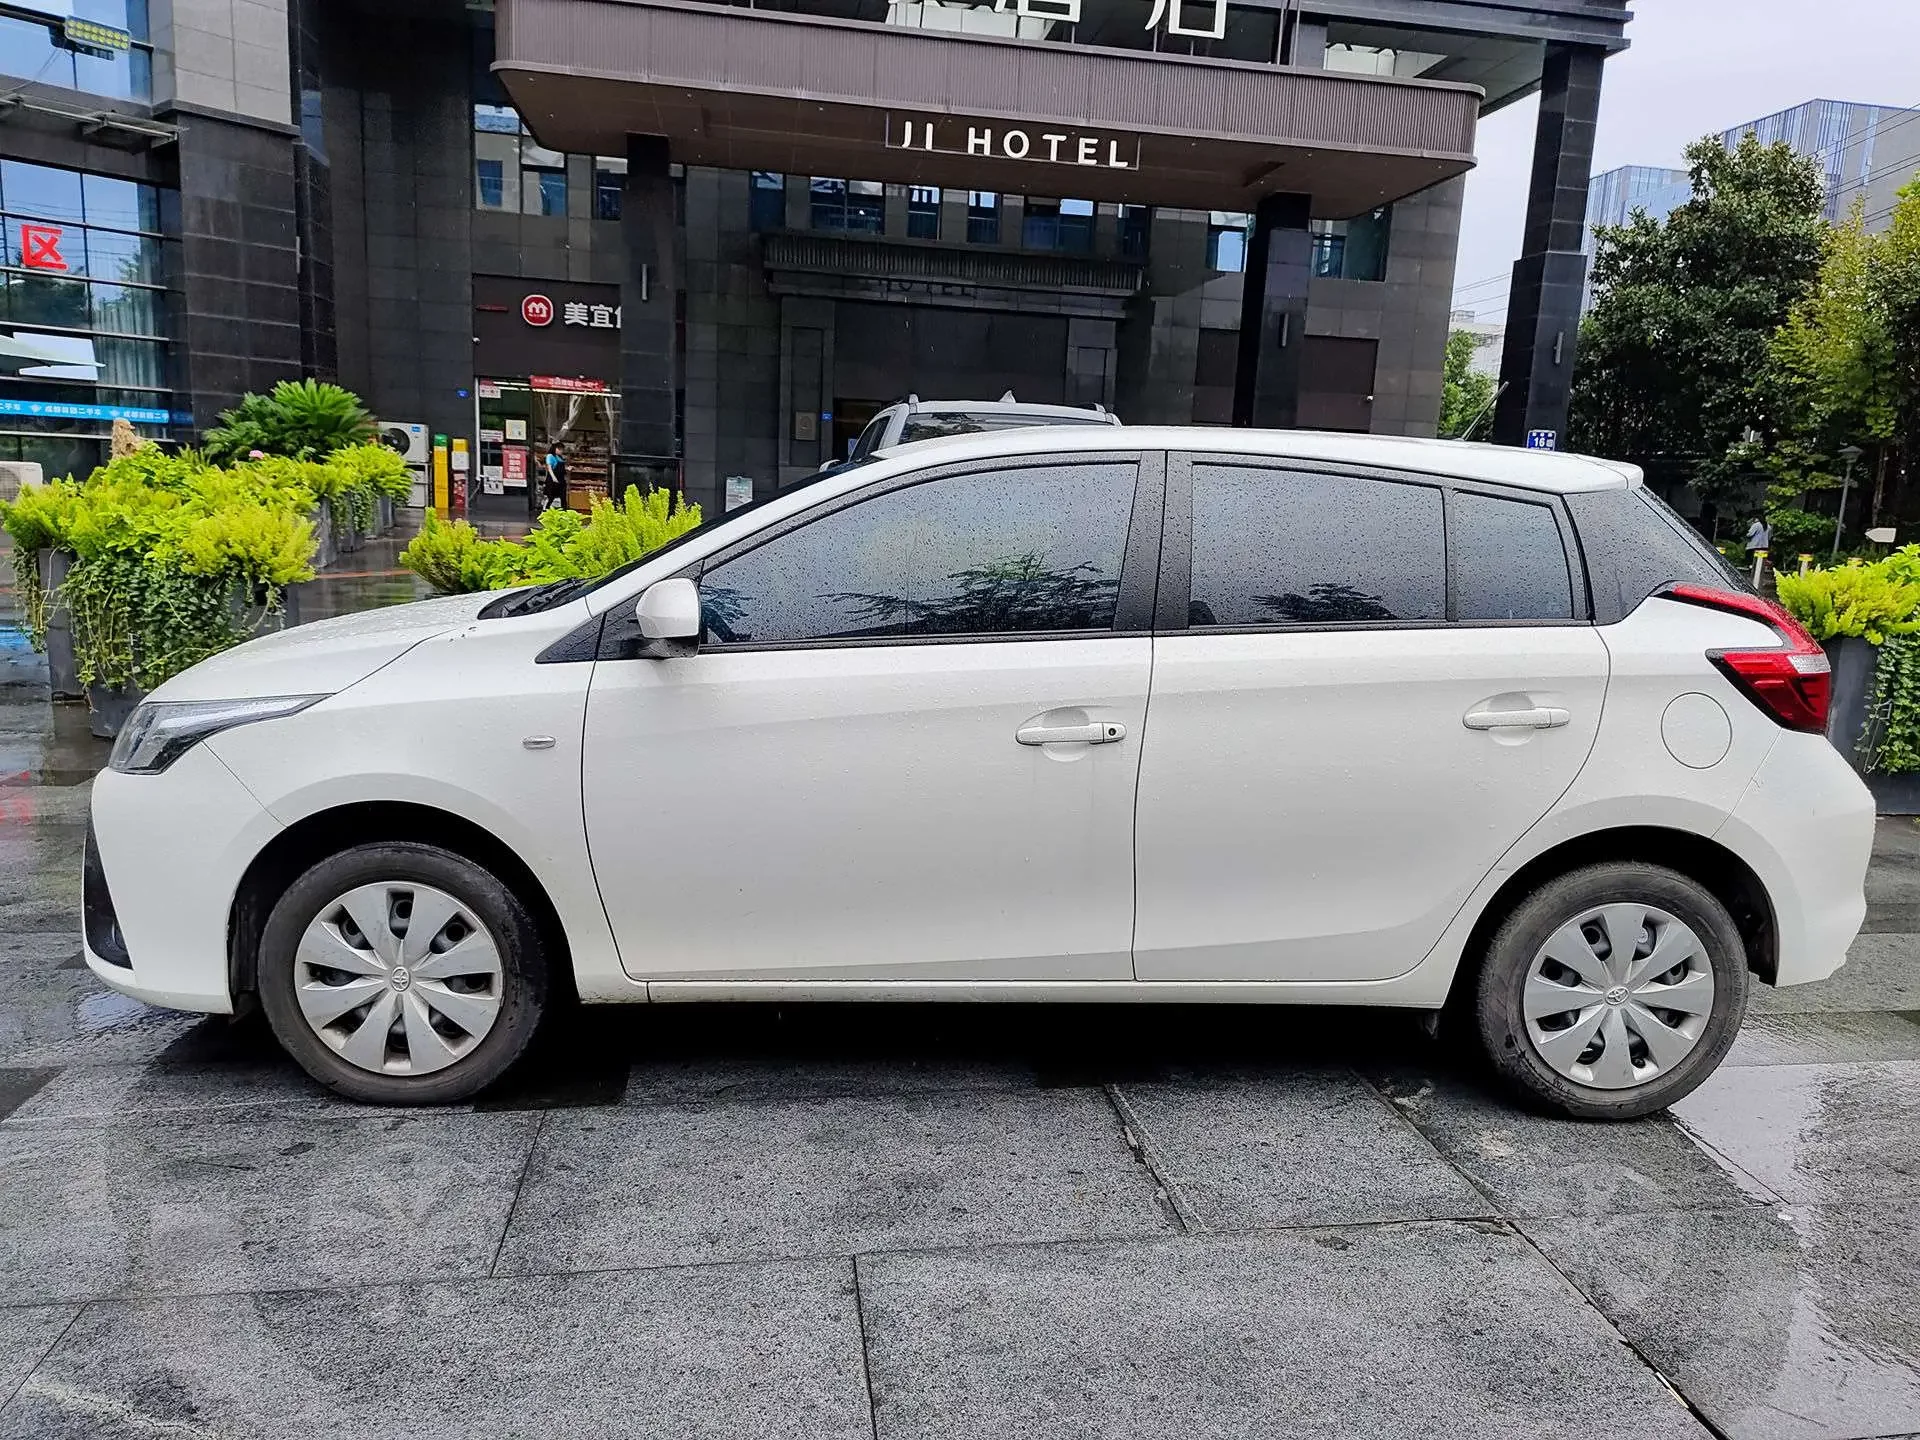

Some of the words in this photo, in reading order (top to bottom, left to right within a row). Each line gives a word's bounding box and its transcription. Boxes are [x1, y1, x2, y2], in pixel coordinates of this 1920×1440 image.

[901, 120, 934, 151] JI
[967, 126, 1129, 168] HOTEL
[22, 224, 67, 270] 区
[564, 301, 622, 329] 美宜
